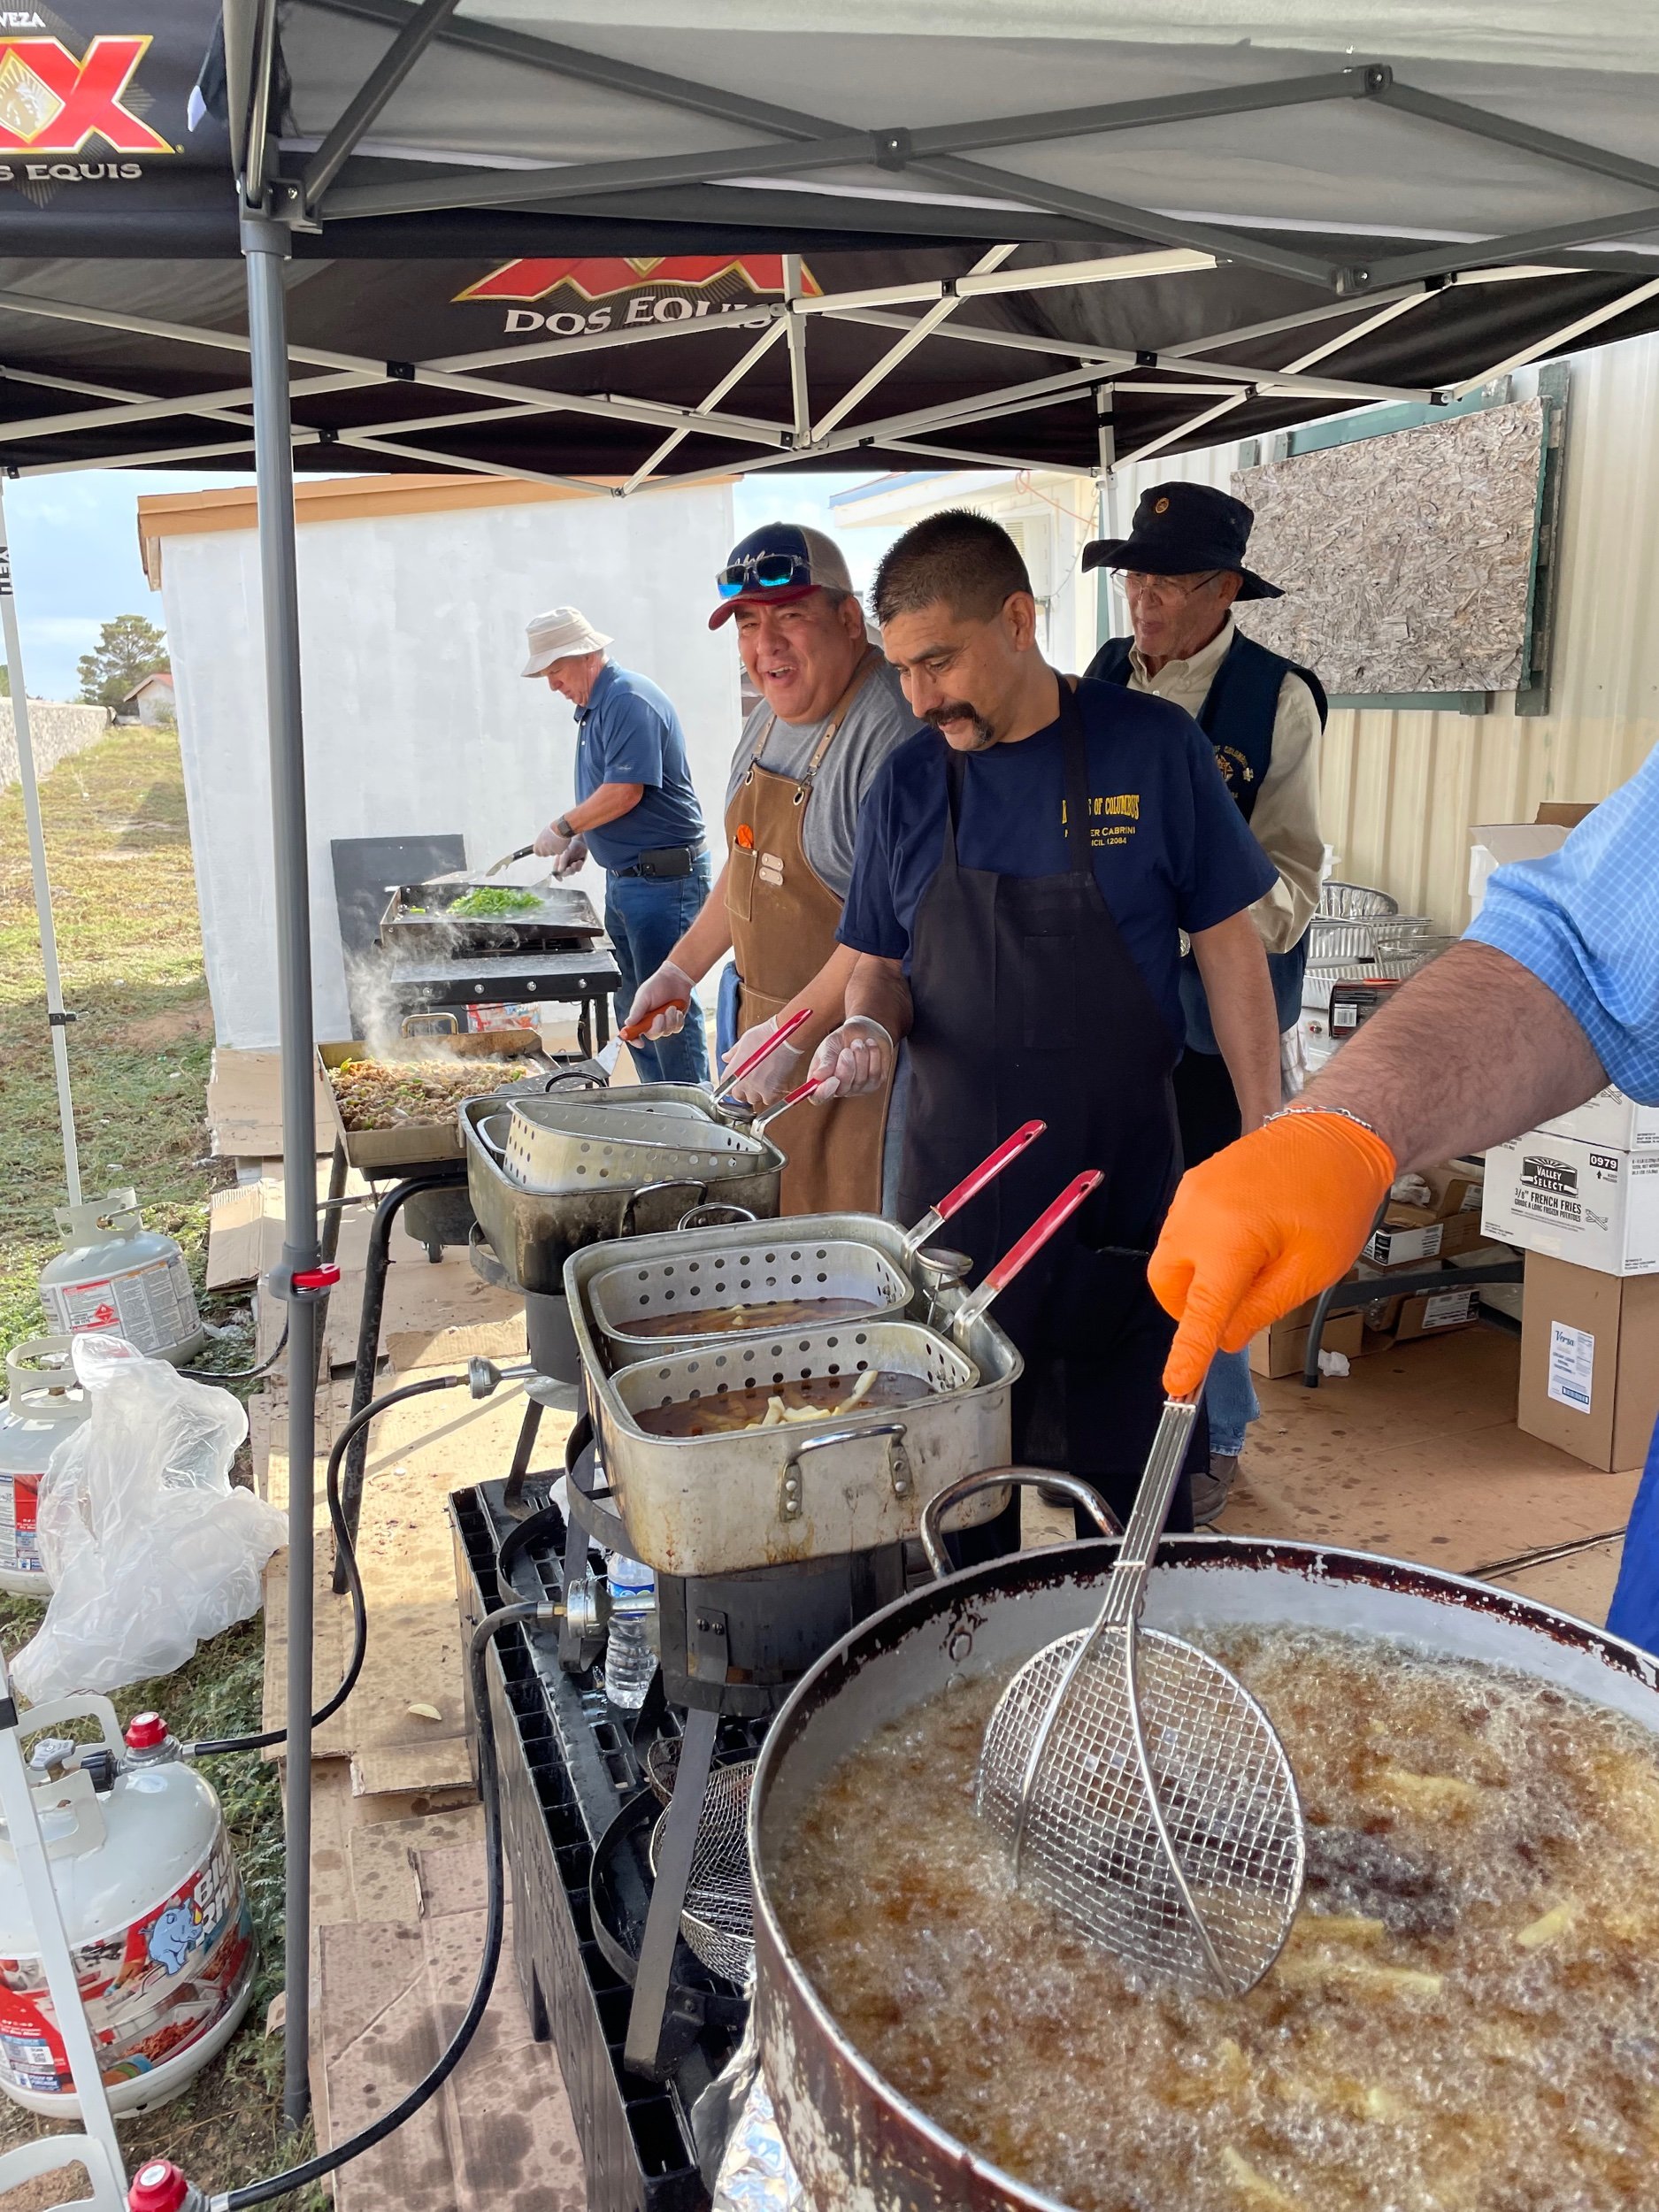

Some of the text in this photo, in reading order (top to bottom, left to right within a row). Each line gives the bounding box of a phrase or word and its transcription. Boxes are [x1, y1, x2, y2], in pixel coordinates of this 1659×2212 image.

[25, 162, 142, 182] EQUIS
[503, 306, 611, 335] DOS
[1094, 797, 1103, 816] OF
[1104, 794, 1140, 820] COLUMBUS
[1102, 826, 1136, 836] CABRINI
[1107, 836, 1127, 845] 12084
[1590, 1155, 1617, 1170] 0979
[1536, 1165, 1563, 1181] VALLEY
[1532, 1175, 1563, 1192] SELECT
[1531, 1192, 1558, 1209] FRENCH
[1560, 1200, 1582, 1215] FRIES
